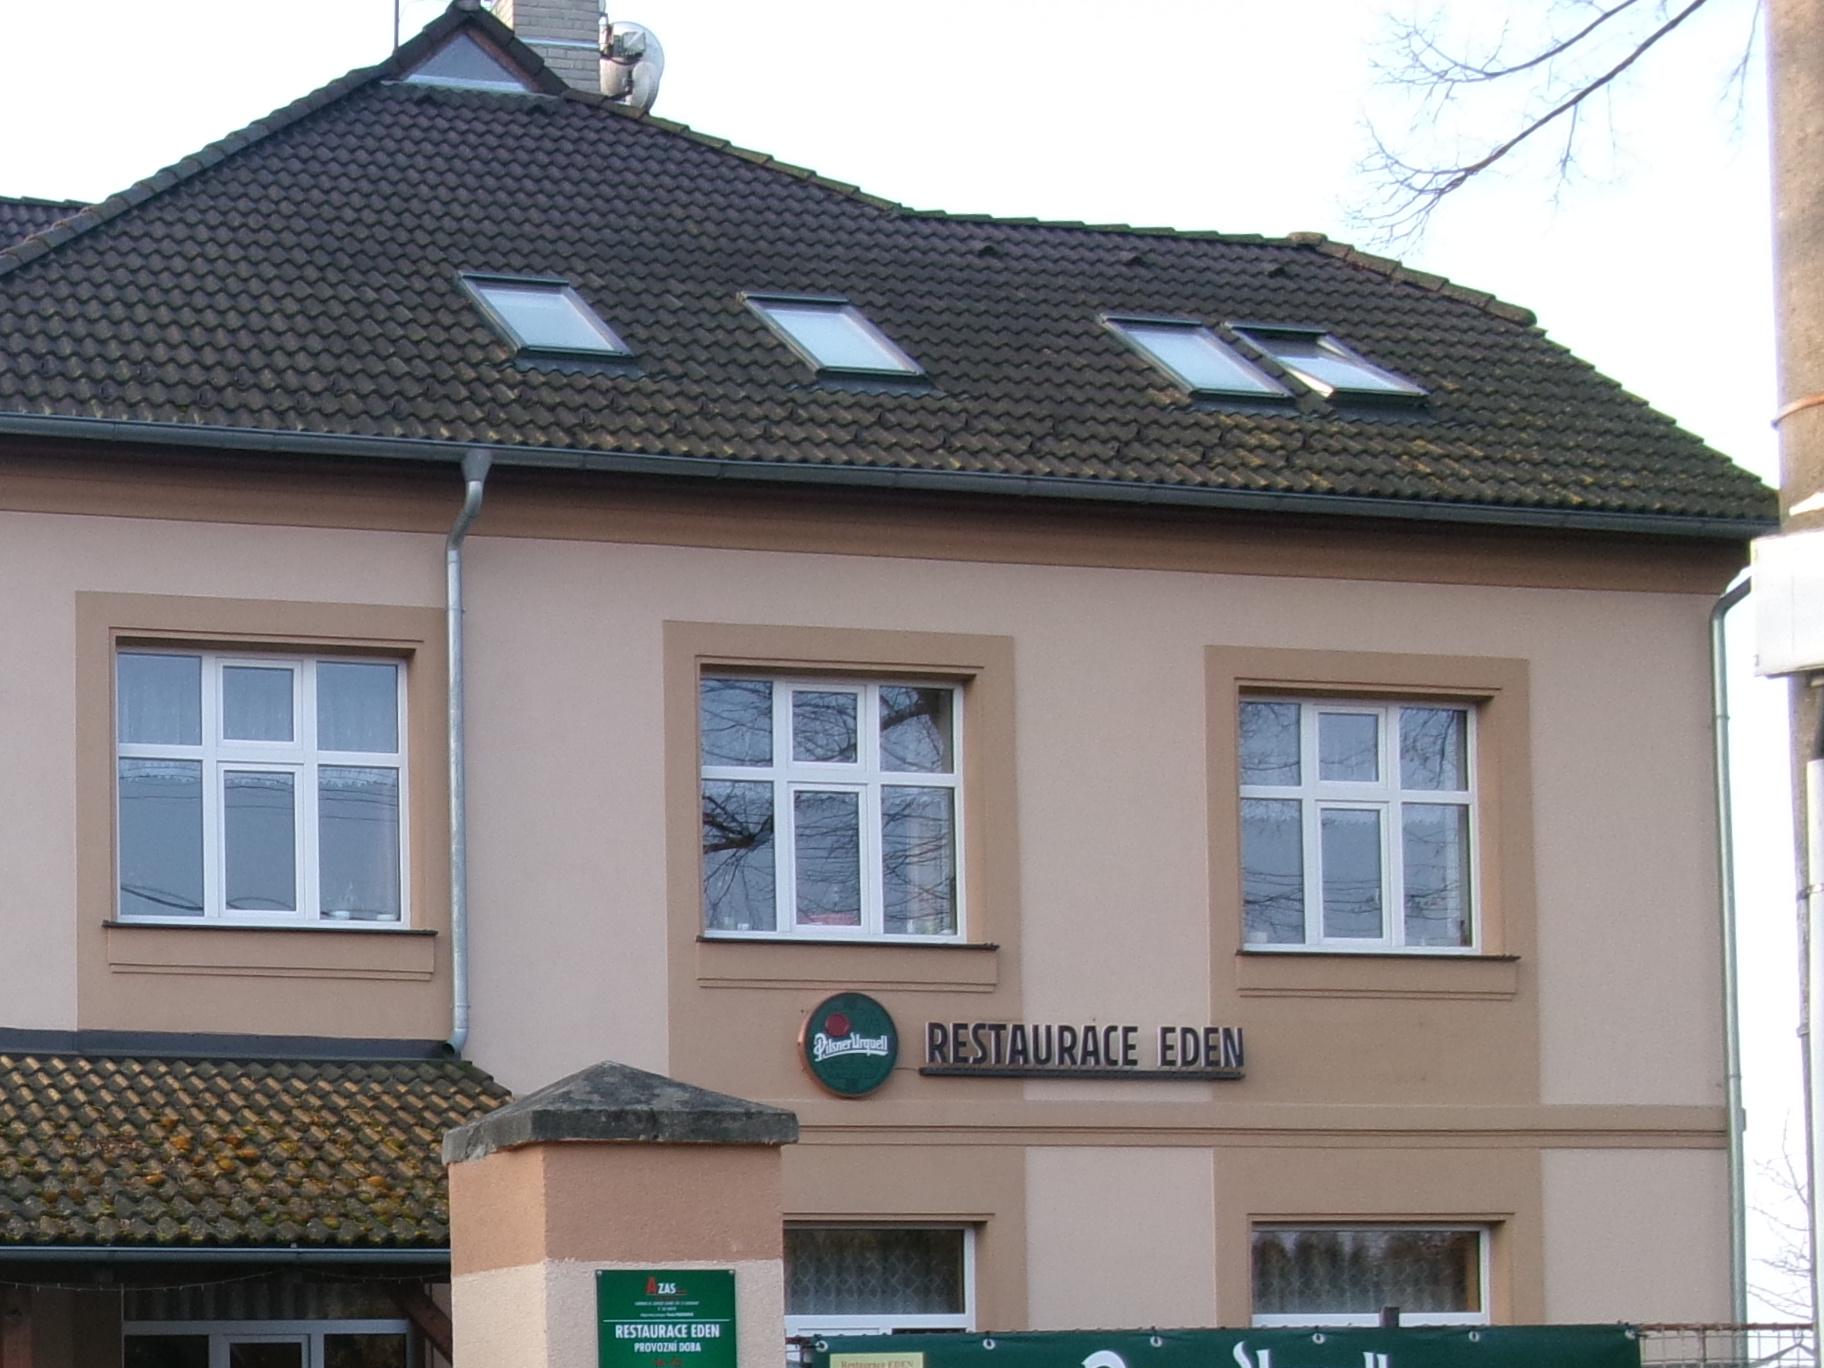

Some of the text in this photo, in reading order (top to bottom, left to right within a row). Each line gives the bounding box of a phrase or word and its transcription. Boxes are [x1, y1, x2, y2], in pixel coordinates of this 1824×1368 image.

[813, 1032, 888, 1062] Pilsner Urquell
[925, 1022, 1245, 1068] RESTAURACE EDEN
[615, 1324, 720, 1338] RESTAURACE EDEN
[634, 1341, 701, 1353] PROVOZNÍ DOBA
